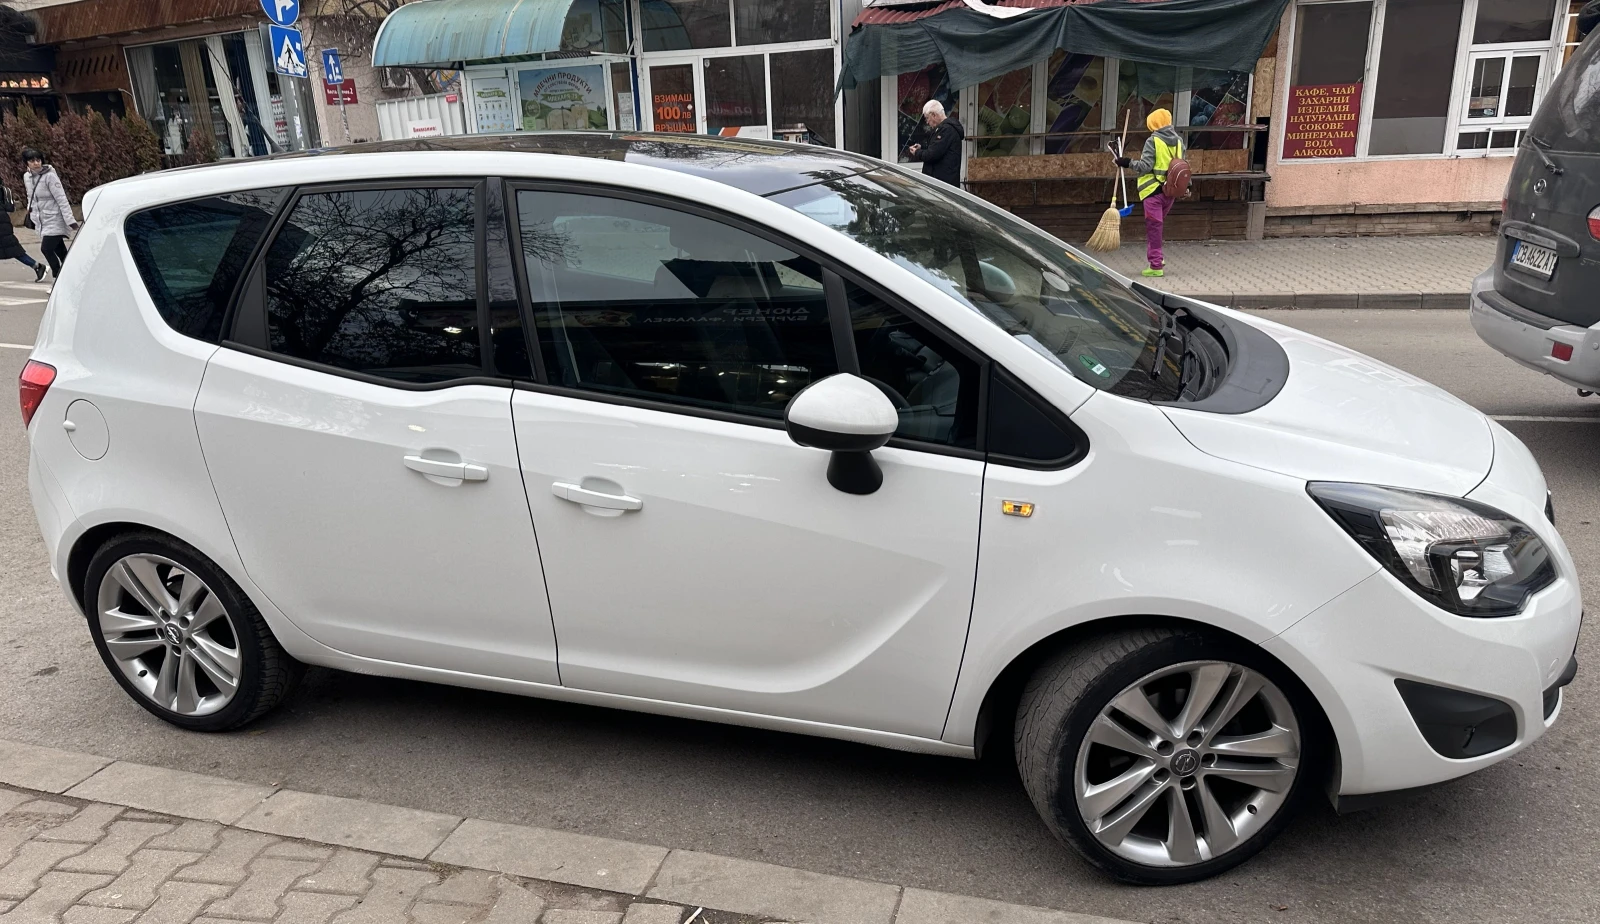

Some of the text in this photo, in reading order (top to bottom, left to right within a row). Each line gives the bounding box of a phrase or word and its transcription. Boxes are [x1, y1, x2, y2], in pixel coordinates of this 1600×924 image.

[533, 72, 592, 97] МЛЕЧНИ ПРОДУКТИ
[1295, 85, 1356, 97] КАФЕ, ЧАЙ
[654, 93, 692, 103] ВЗИМАШ
[1299, 96, 1350, 105] ЗАХАРНИ
[656, 106, 681, 120] 100
[1297, 105, 1350, 114] ИЗДЕЛИЯ
[1290, 113, 1356, 123] НАТУРАЛНИ
[654, 122, 695, 132] ВРЪЩАШ
[1299, 122, 1344, 131] СОКОВЕ
[1286, 130, 1355, 140] МИНЕРАЛНА
[1304, 140, 1334, 148] ВОДА
[1293, 148, 1343, 157] АЛКОХОЛ
